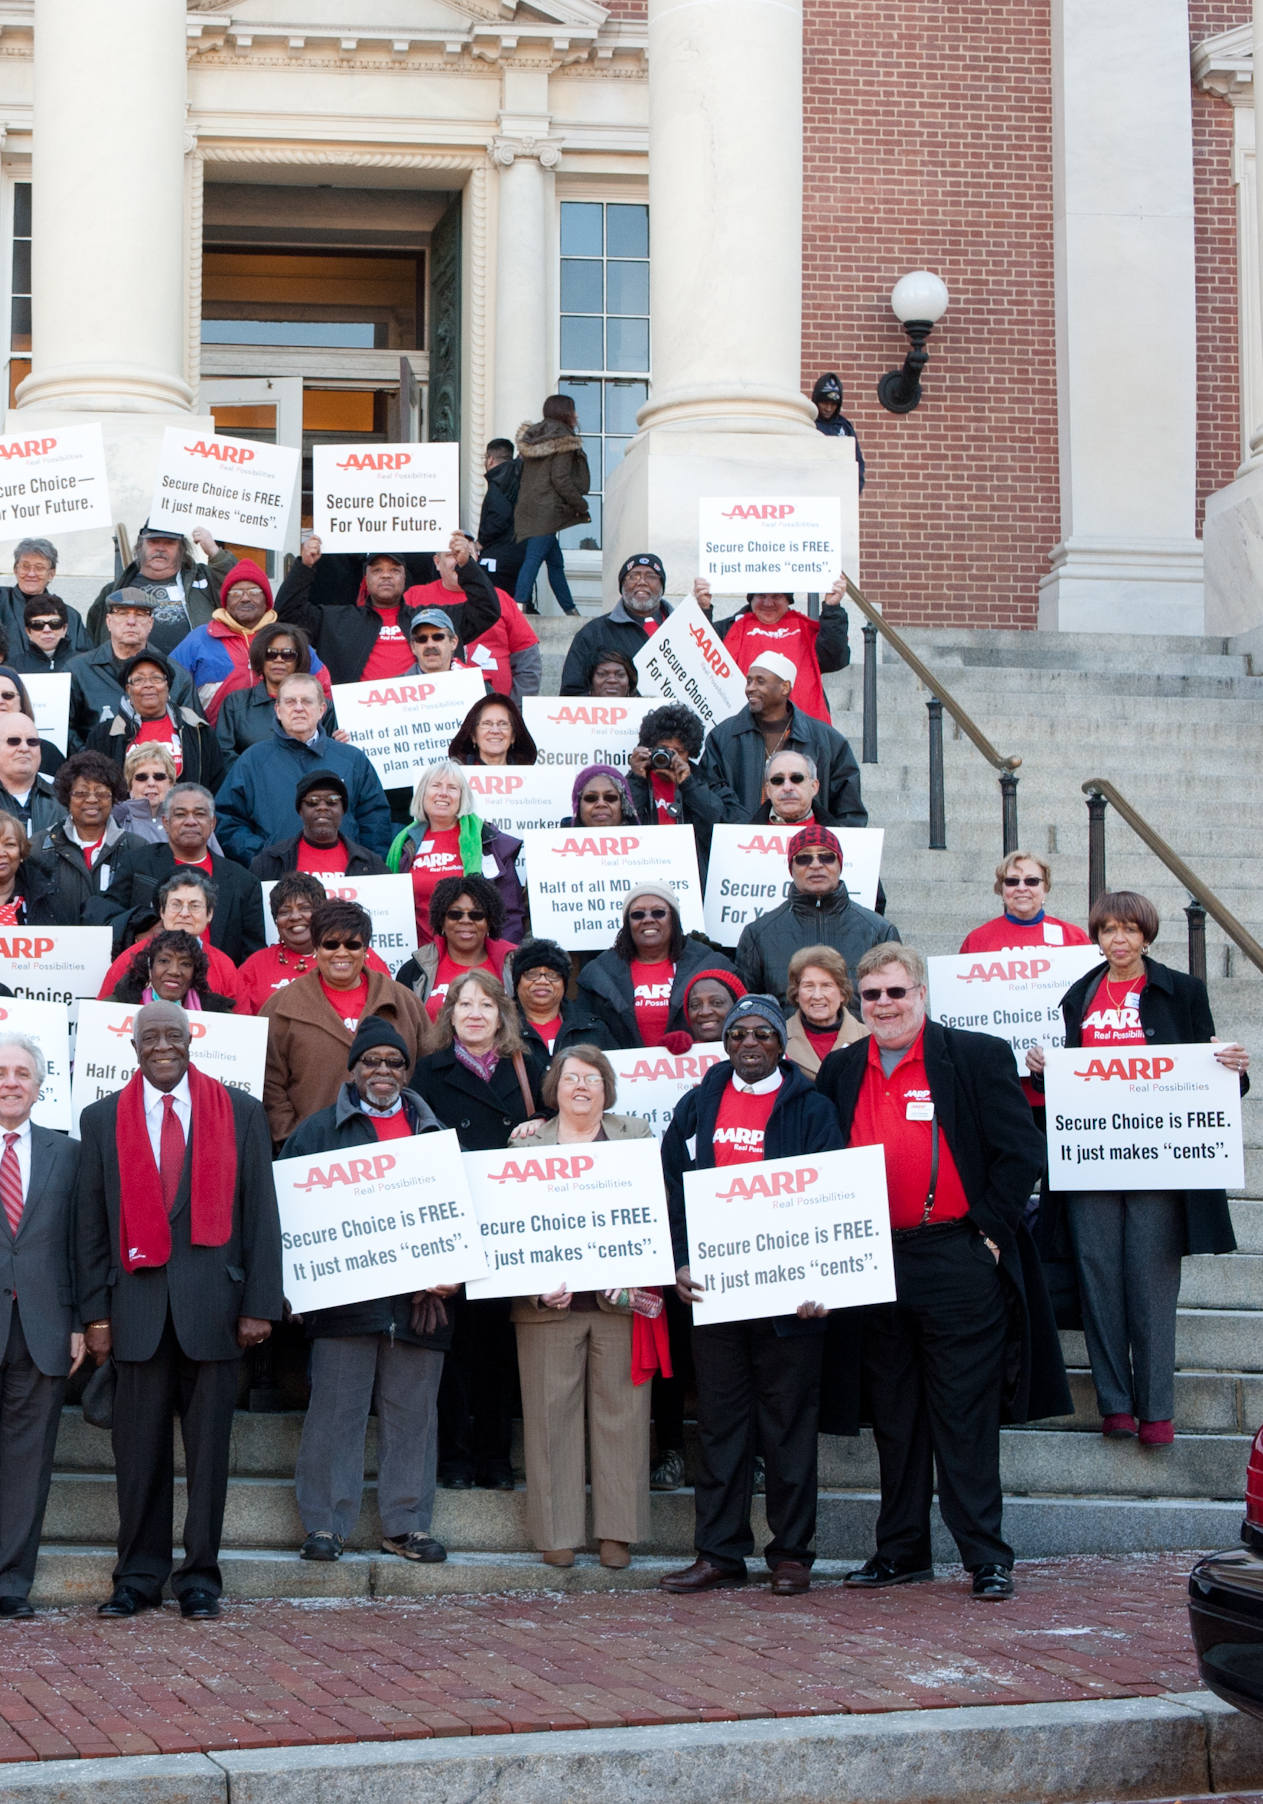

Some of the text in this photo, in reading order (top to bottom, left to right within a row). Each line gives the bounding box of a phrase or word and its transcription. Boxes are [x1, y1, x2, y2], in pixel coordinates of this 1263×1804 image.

[183, 440, 255, 464] AARP
[335, 452, 411, 471] AARP
[161, 474, 284, 508] Secure Choice is FREE.
[326, 493, 374, 509] Secure
[10, 503, 40, 519] Your
[44, 497, 93, 514] Future.
[160, 496, 170, 509] It
[170, 498, 193, 514] just
[194, 505, 230, 520] makes
[720, 503, 795, 520] AARP
[330, 515, 442, 532] For Your Future.
[705, 540, 834, 553] Secure Choice is FREE.
[709, 561, 717, 572] It
[720, 561, 742, 575] just
[744, 560, 781, 572] makes
[658, 638, 688, 682] Secure
[689, 623, 731, 679] AARP
[357, 682, 436, 708] AARP
[350, 721, 431, 742] Half of all MD
[551, 835, 640, 857] AARP
[601, 856, 672, 866] Real Possibilities
[539, 878, 631, 894] Half of all MD
[955, 958, 1051, 984] AARP
[1094, 1030, 1111, 1040] Real
[1073, 1056, 1174, 1081] AARP
[1129, 1082, 1209, 1092] Real Possibilities
[1055, 1110, 1231, 1131] Secure Choice is FREE.
[712, 1127, 765, 1146] AARP
[1060, 1144, 1072, 1161] It
[1076, 1144, 1105, 1164] just
[1109, 1143, 1159, 1160] makes
[294, 1154, 395, 1192] AARP
[487, 1154, 594, 1184] AARP
[714, 1166, 819, 1203] AARP
[697, 1218, 879, 1260] Secure Choice is FREE.
[292, 1262, 306, 1281] It
[309, 1256, 341, 1283] just
[344, 1249, 398, 1272] makes
